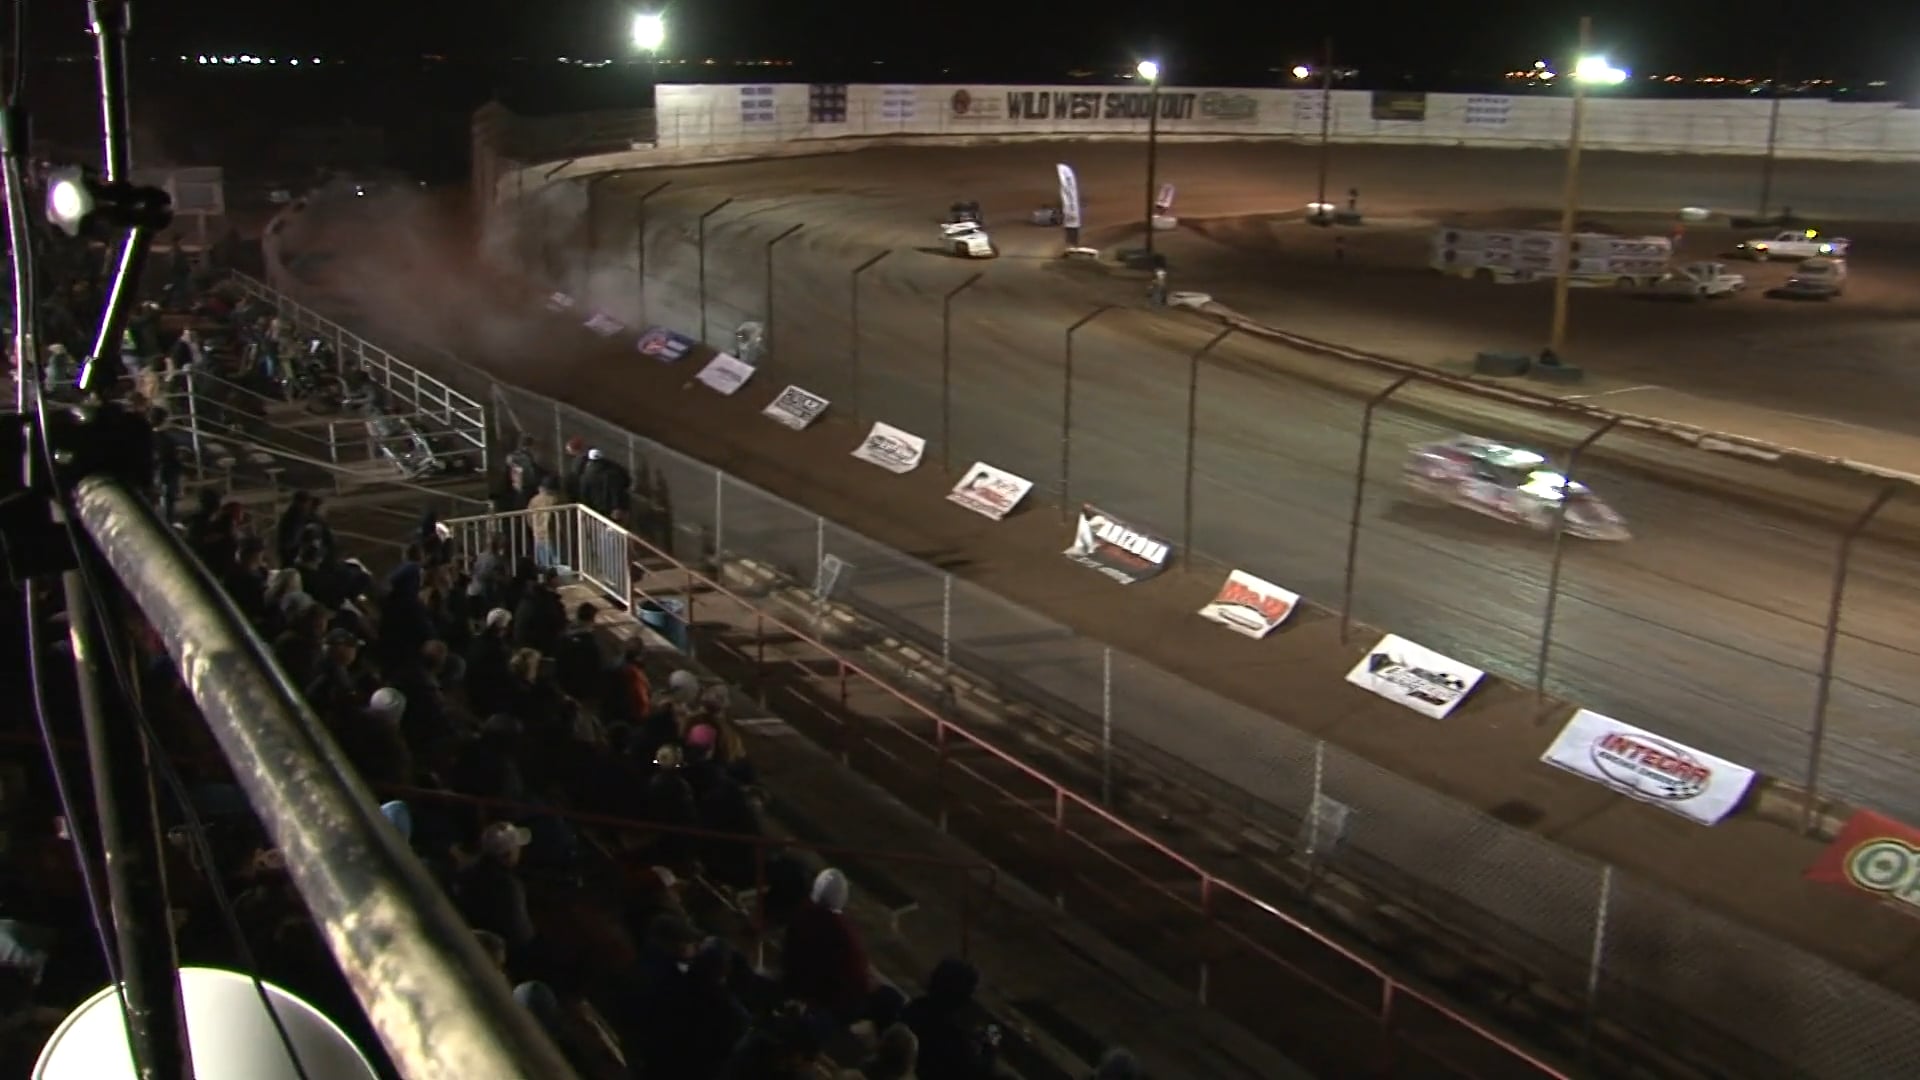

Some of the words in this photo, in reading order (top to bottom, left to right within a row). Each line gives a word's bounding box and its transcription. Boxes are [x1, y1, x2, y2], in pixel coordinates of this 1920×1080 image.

[1007, 91, 1050, 119] WILD
[1054, 91, 1102, 119] WEST
[1095, 519, 1169, 564] ARIZONA
[1598, 731, 1712, 784] INTEGRA
